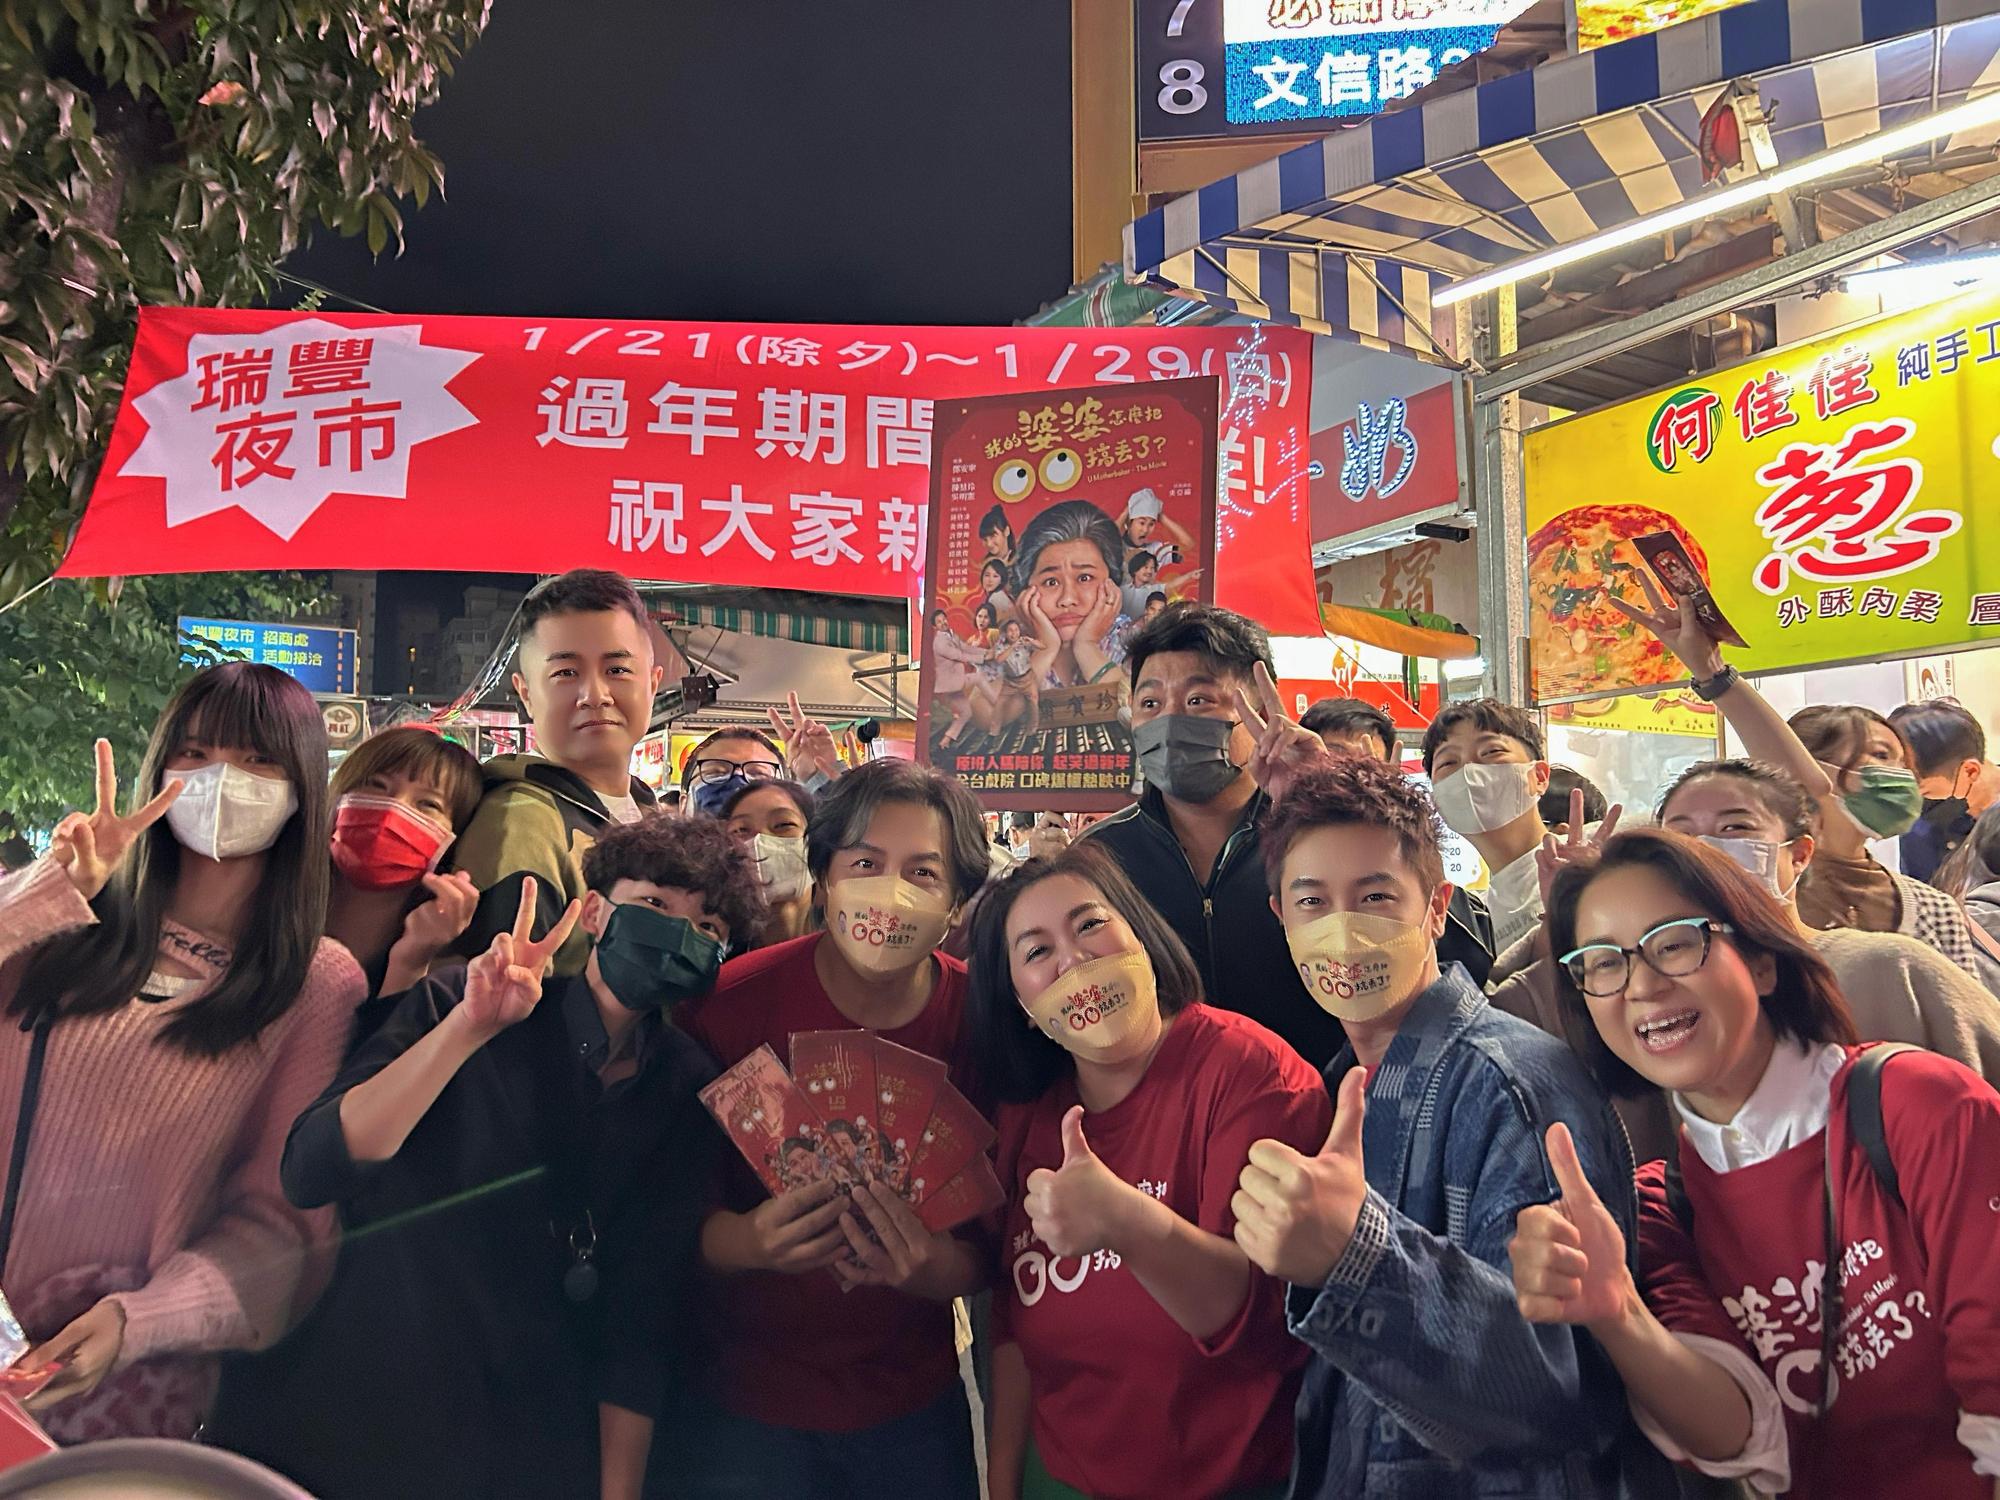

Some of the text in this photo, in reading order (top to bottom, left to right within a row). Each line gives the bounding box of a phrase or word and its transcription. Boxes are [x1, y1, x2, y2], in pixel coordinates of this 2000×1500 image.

[1166, 0, 1194, 37] 7
[1157, 59, 1208, 115] 8
[191, 338, 374, 413] 瑞豐
[211, 397, 402, 492] 夜市
[535, 376, 934, 470] 過年期間
[1450, 847, 1461, 856] 20
[1450, 863, 1462, 872] 20
